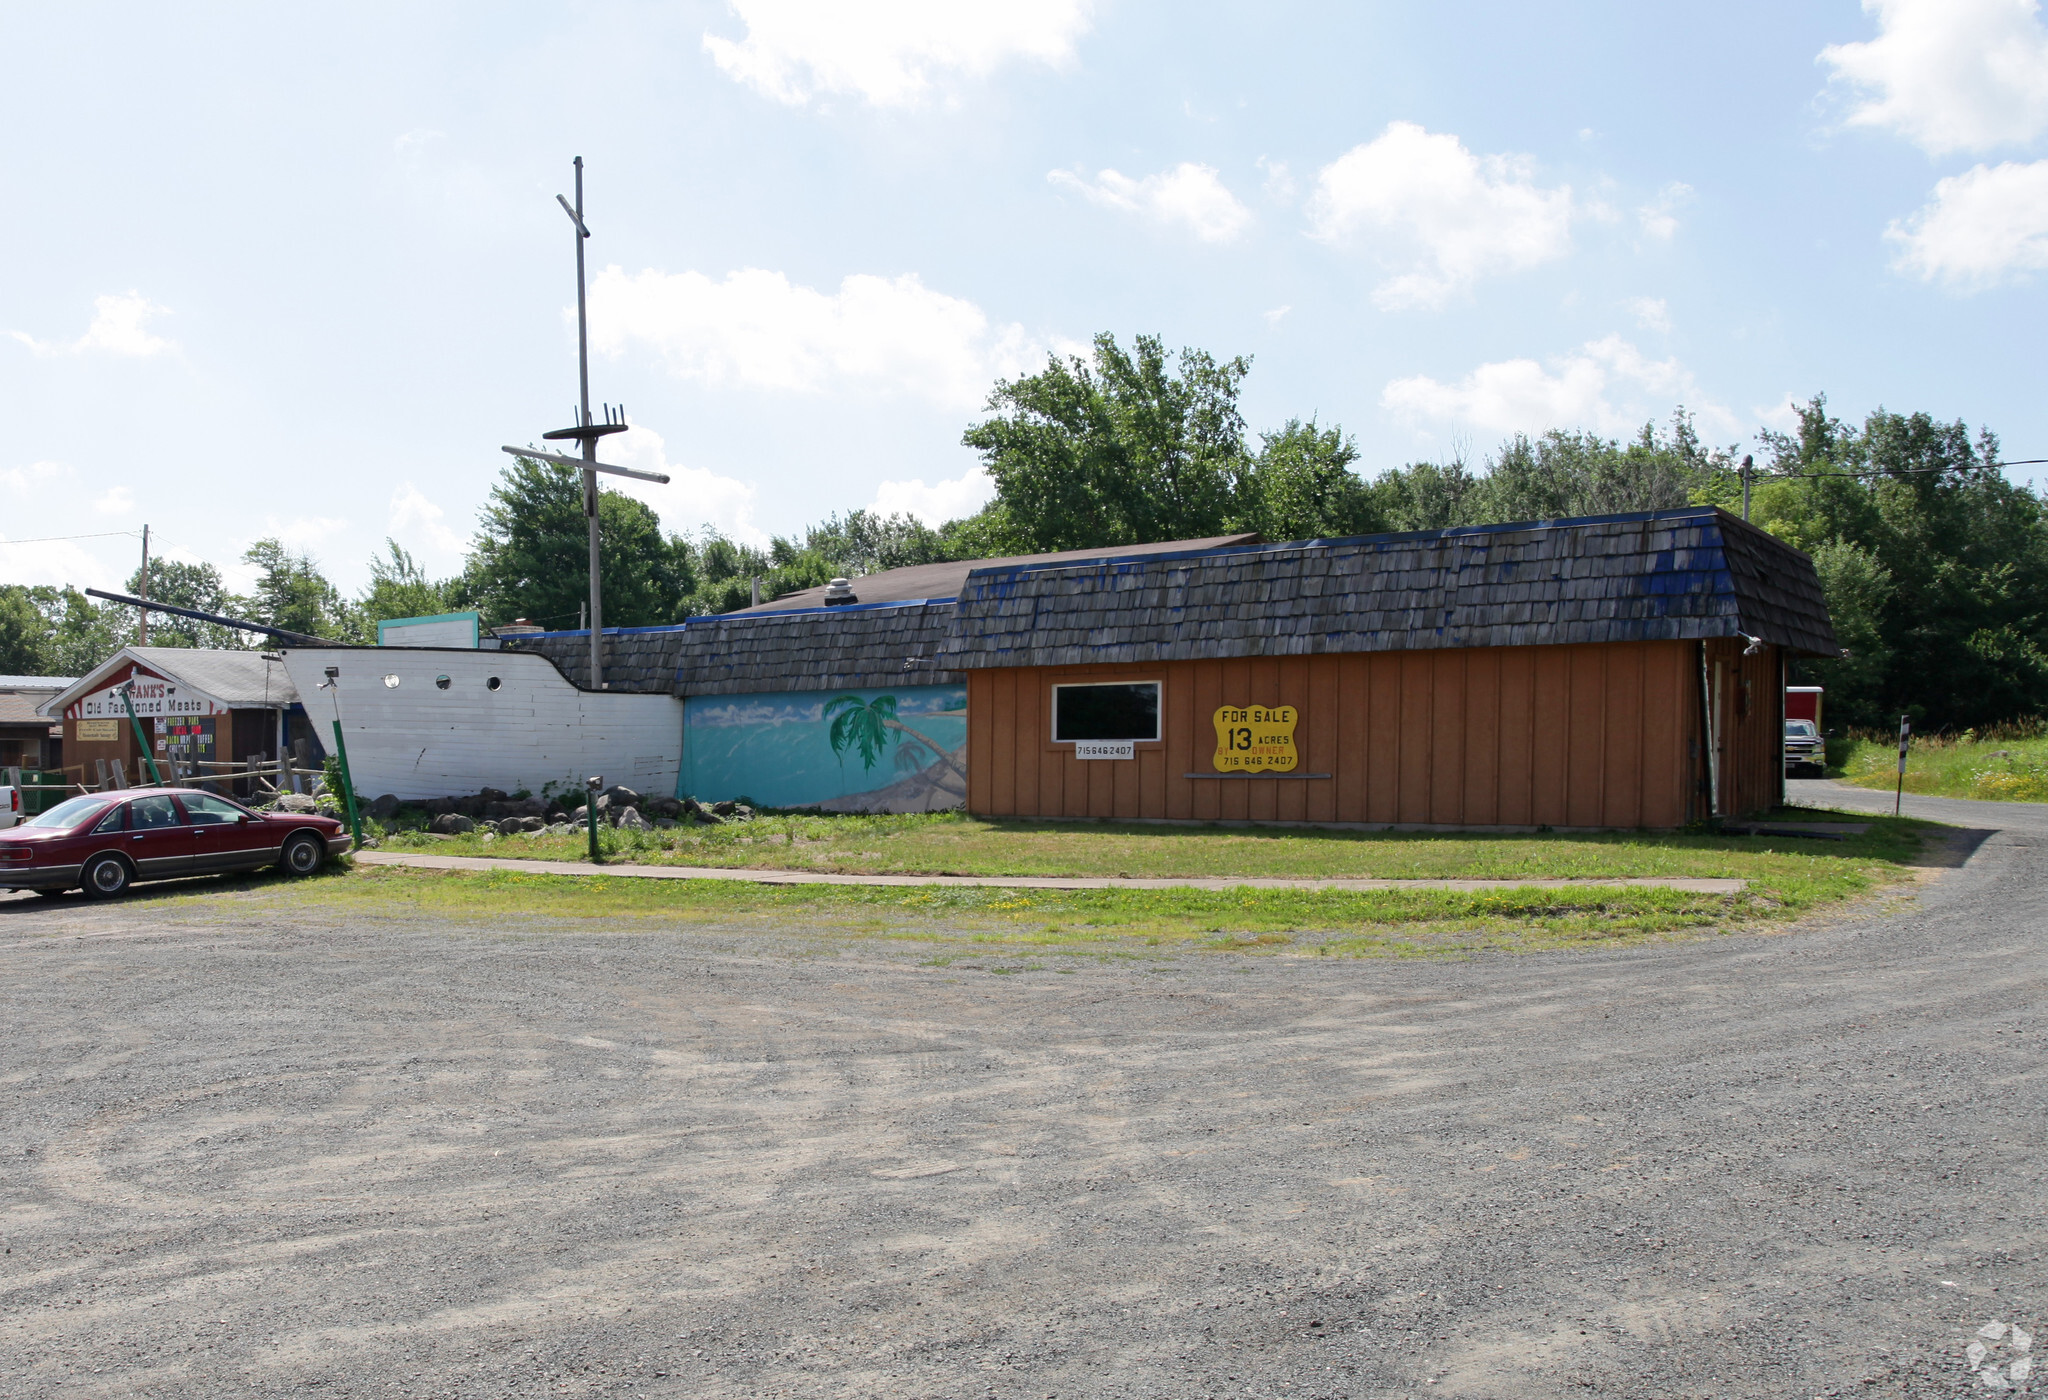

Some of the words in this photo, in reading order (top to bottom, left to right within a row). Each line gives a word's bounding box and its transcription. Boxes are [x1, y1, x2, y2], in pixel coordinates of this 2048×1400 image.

[87, 703, 102, 714] Old
[108, 699, 162, 714] Fasioned
[168, 700, 202, 712] Meats
[1222, 711, 1248, 722] FOR
[1254, 711, 1290, 722] SALE
[1228, 727, 1252, 750] 13
[1258, 736, 1289, 744] ACRES
[1218, 746, 1229, 756] BY
[1252, 746, 1285, 755] OWNER
[1224, 756, 1239, 765] 715
[1244, 756, 1262, 765] 646
[1268, 756, 1293, 765] 2407
